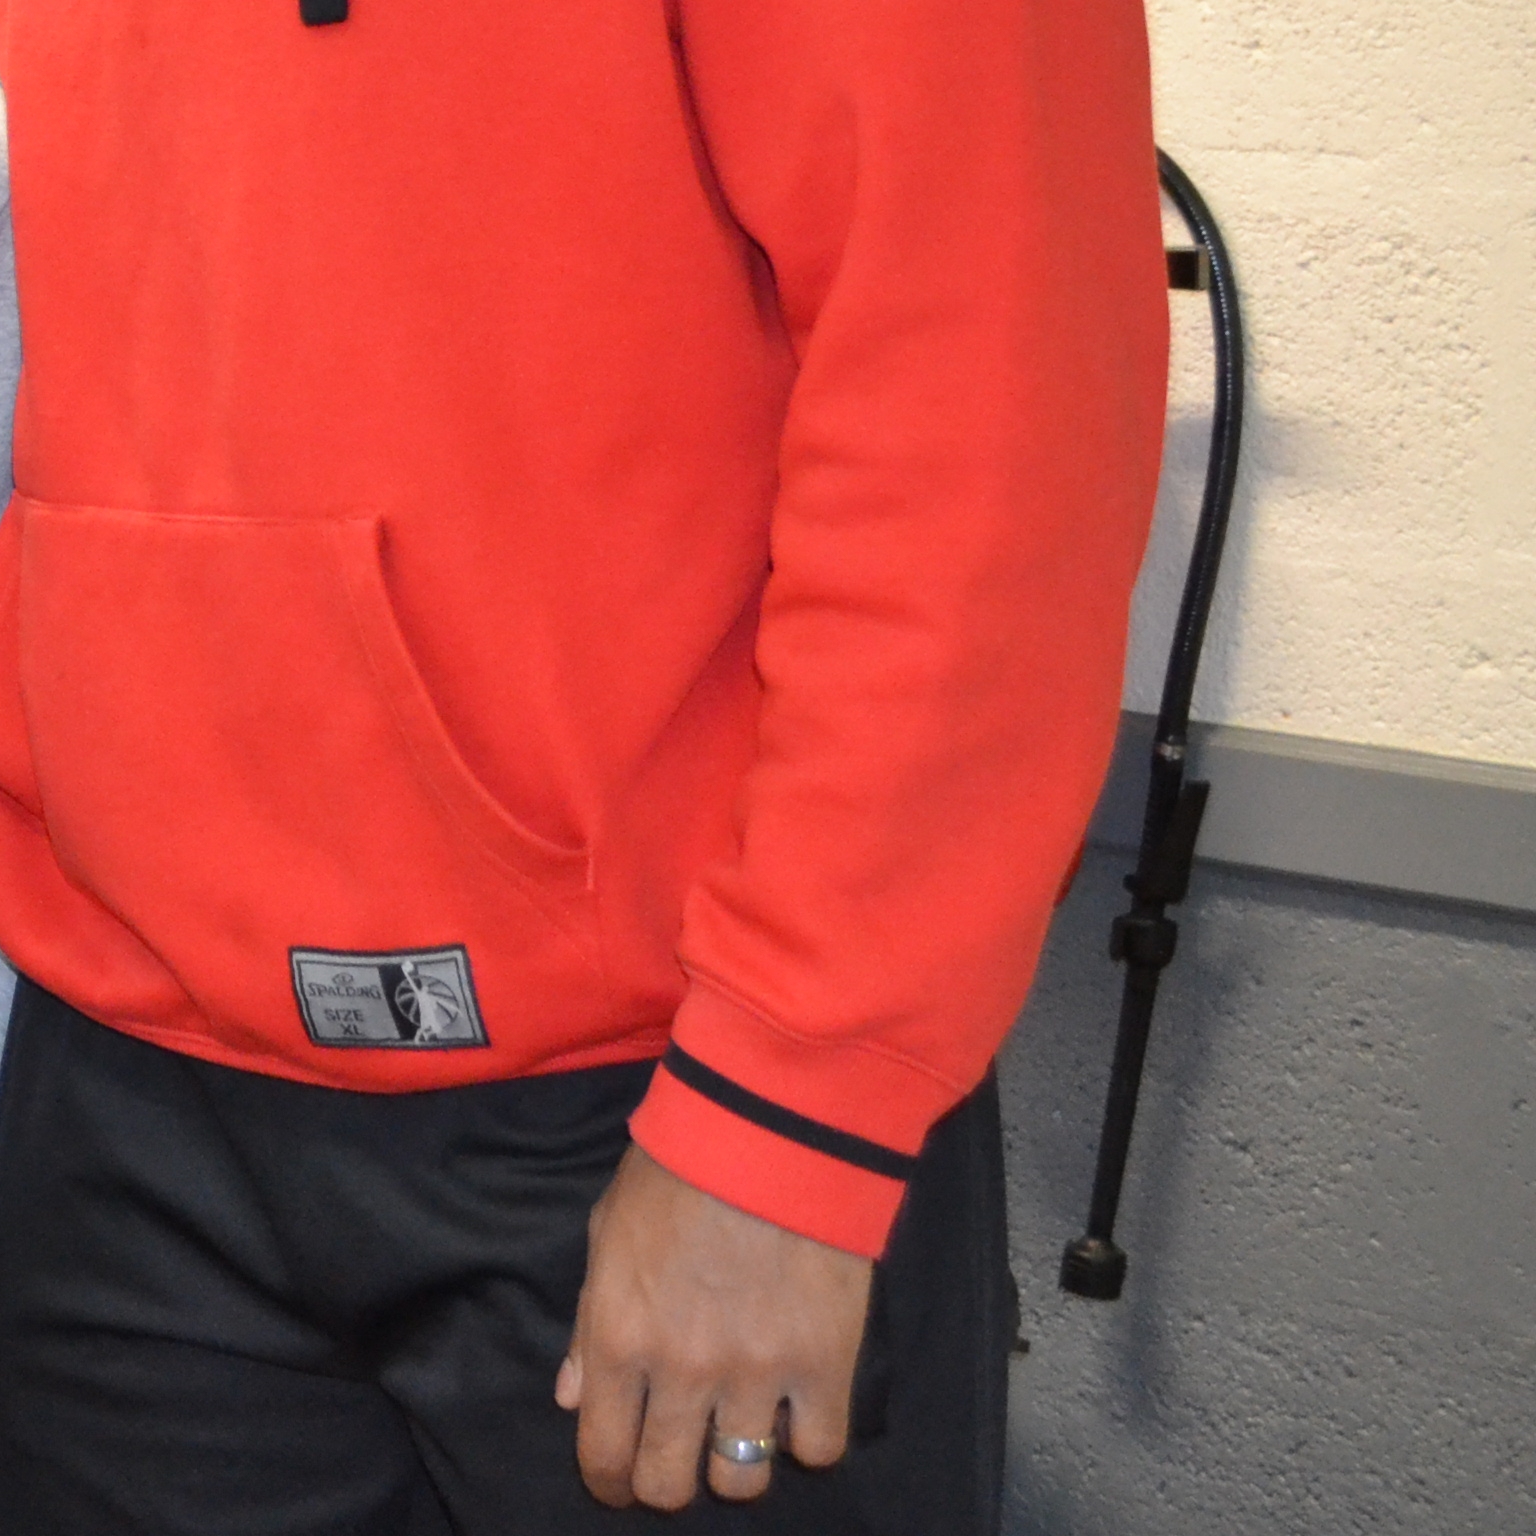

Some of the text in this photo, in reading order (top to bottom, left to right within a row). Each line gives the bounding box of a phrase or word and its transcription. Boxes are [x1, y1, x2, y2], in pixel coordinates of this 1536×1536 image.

[308, 981, 383, 1000] SPALDING
[324, 1008, 365, 1022] SIZE
[341, 1024, 363, 1037] XL
